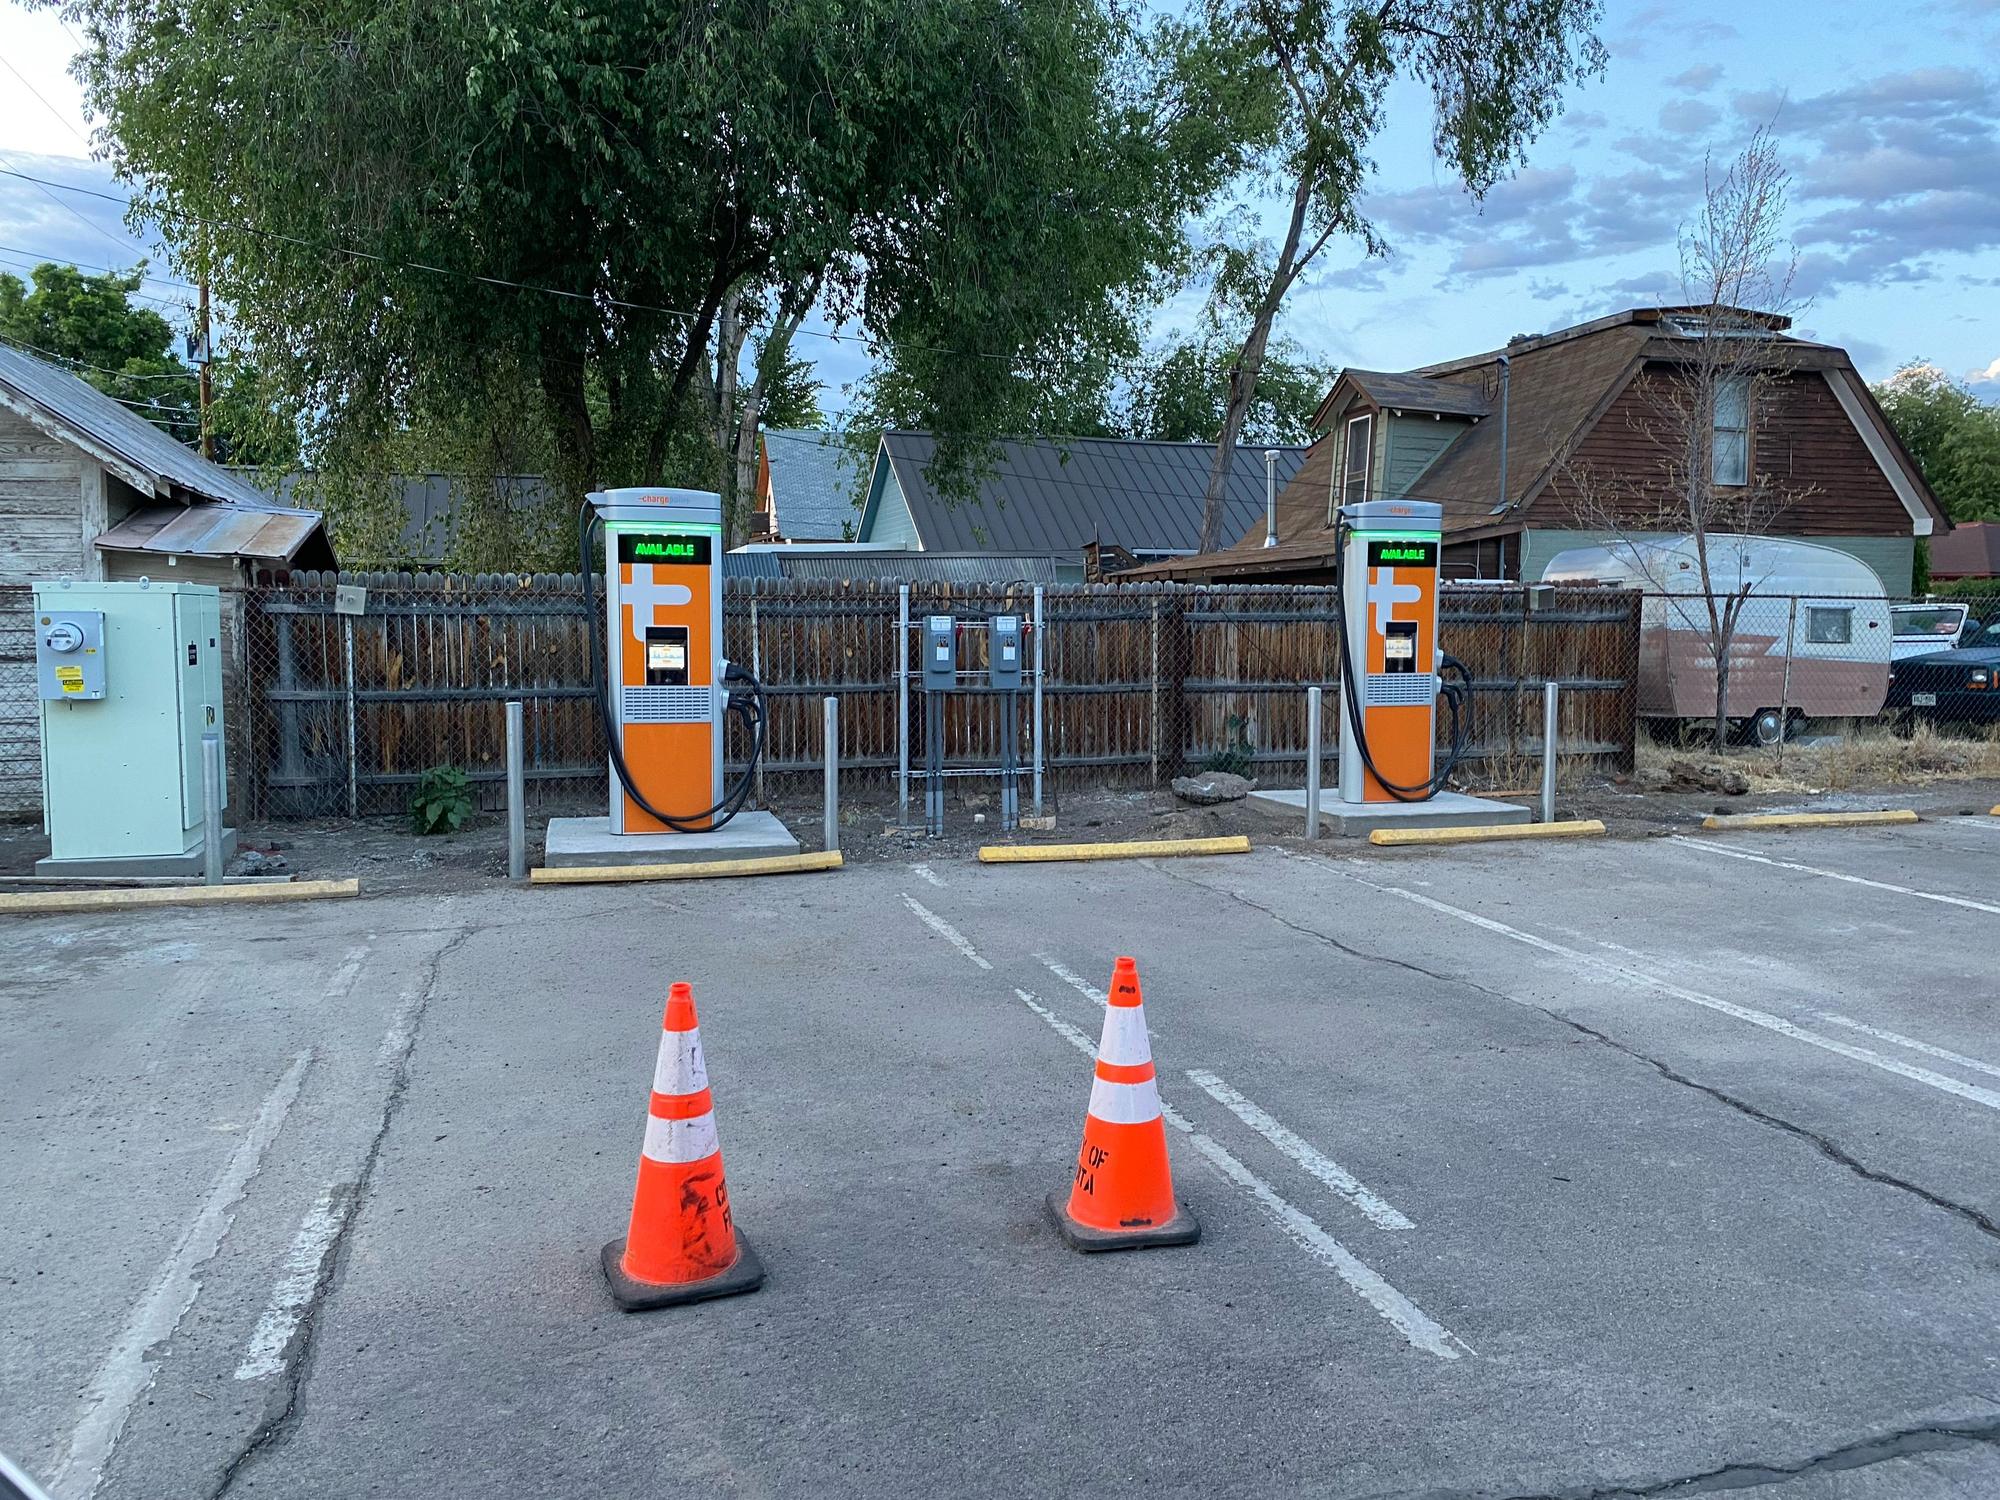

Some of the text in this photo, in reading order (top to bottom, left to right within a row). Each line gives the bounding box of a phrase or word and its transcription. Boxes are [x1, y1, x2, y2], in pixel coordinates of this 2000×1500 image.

[635, 543, 694, 556] AVAILABLE
[1380, 549, 1425, 560] AVAILABLE
[1089, 1145, 1110, 1168] OF
